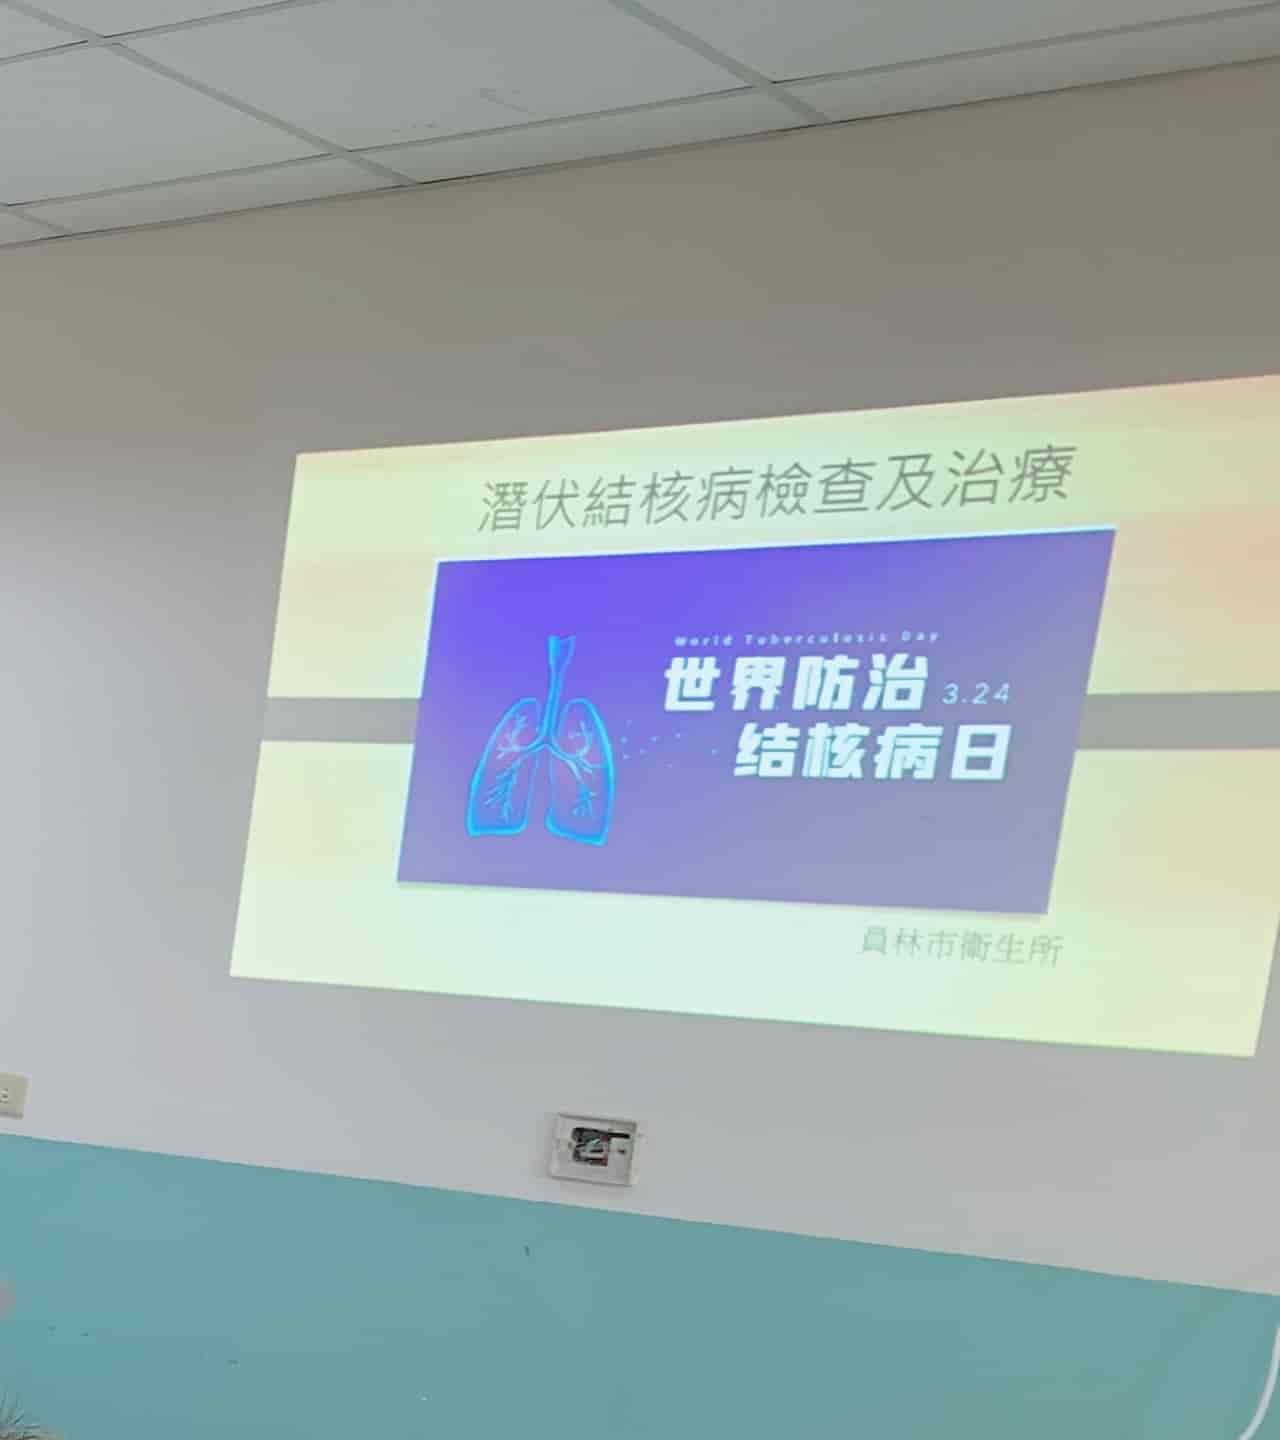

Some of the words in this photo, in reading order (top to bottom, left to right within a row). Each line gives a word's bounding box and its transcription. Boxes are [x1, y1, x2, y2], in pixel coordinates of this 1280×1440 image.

[478, 443, 1077, 532] 潛伏結核病檢查及治療
[664, 653, 929, 711] 世界防治
[942, 682, 1011, 705] 3.24
[734, 722, 1013, 780] 结核病日
